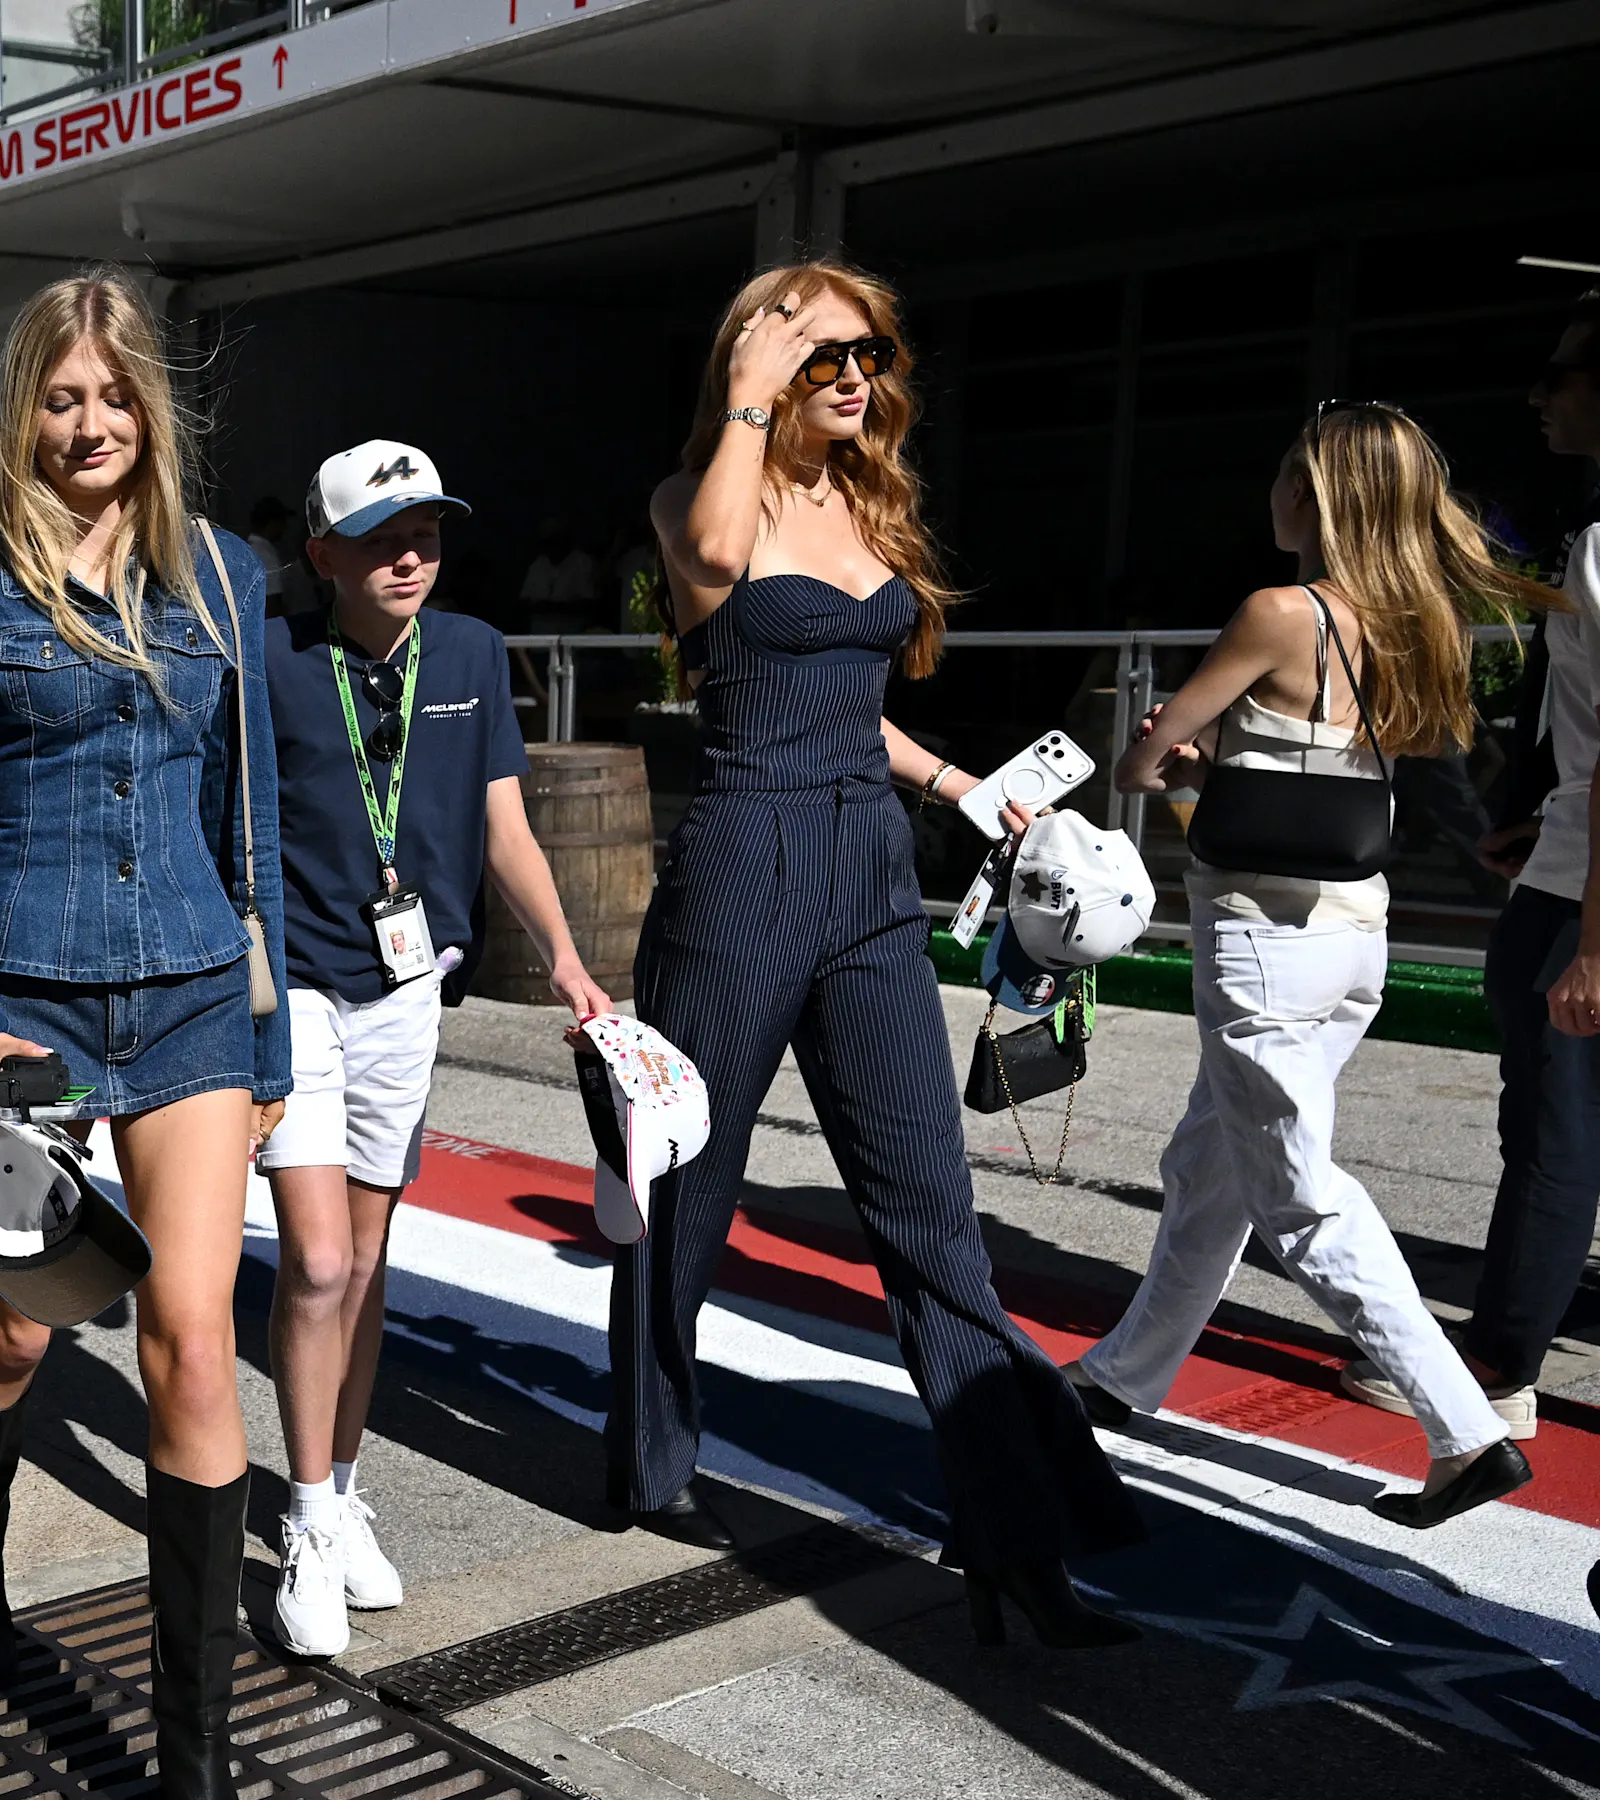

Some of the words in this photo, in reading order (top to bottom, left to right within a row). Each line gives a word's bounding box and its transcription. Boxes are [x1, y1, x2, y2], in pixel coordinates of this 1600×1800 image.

[35, 59, 243, 169] SERVICES
[421, 702, 475, 713] McLaren
[1050, 882, 1062, 910] BWT
